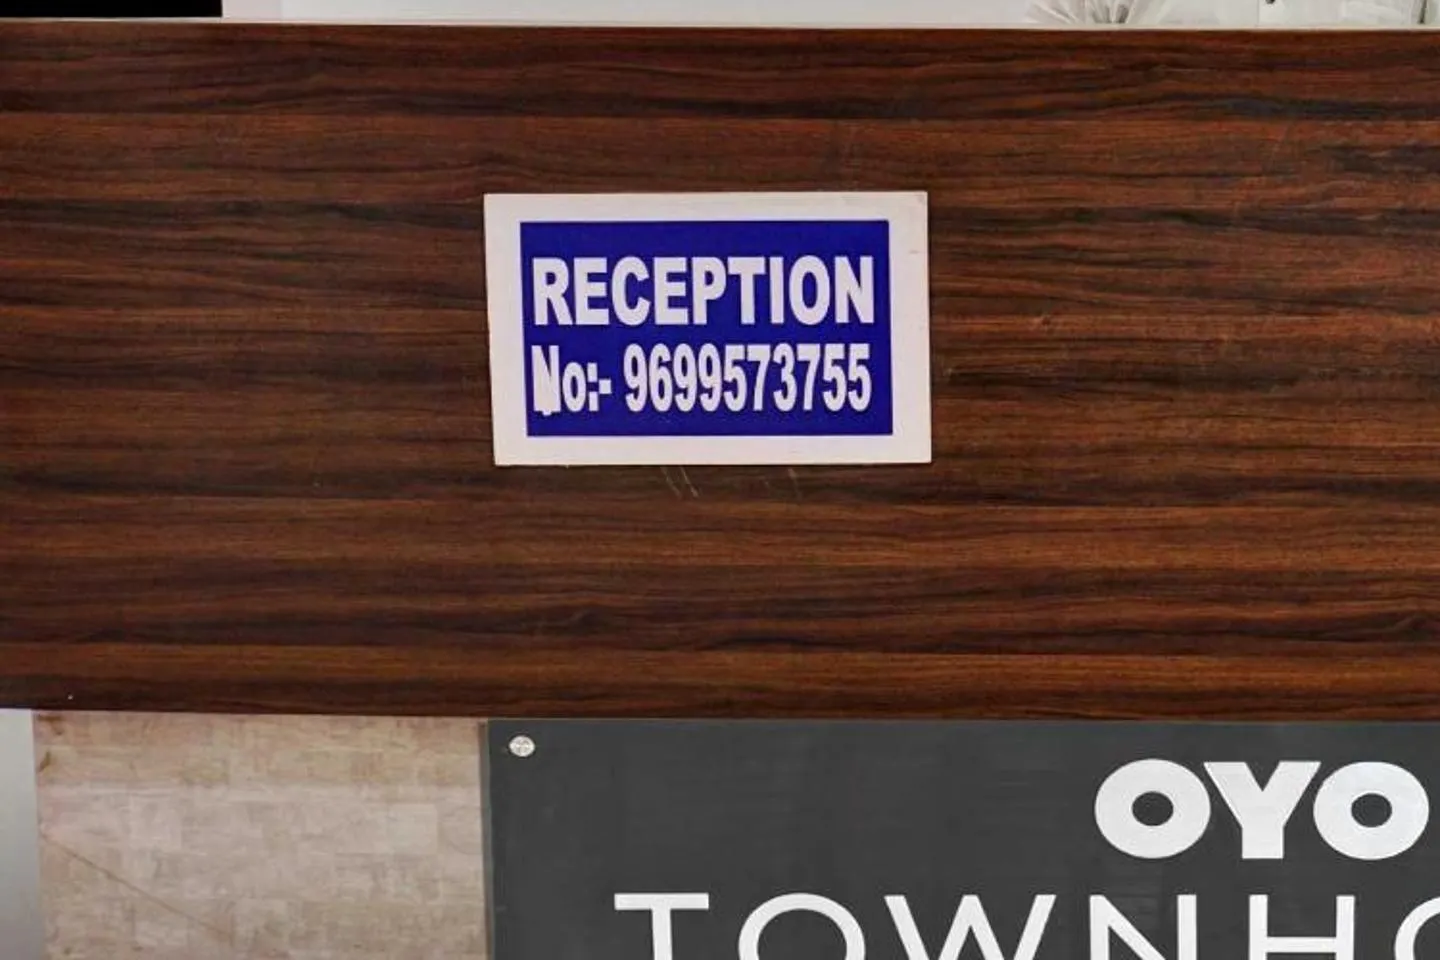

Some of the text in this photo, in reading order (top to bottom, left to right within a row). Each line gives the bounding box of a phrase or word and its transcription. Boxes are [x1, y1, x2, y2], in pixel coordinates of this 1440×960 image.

[532, 255, 874, 326] RECEPTION
[531, 343, 872, 416] No:- 9699573755
[1095, 758, 1430, 861] OYO
